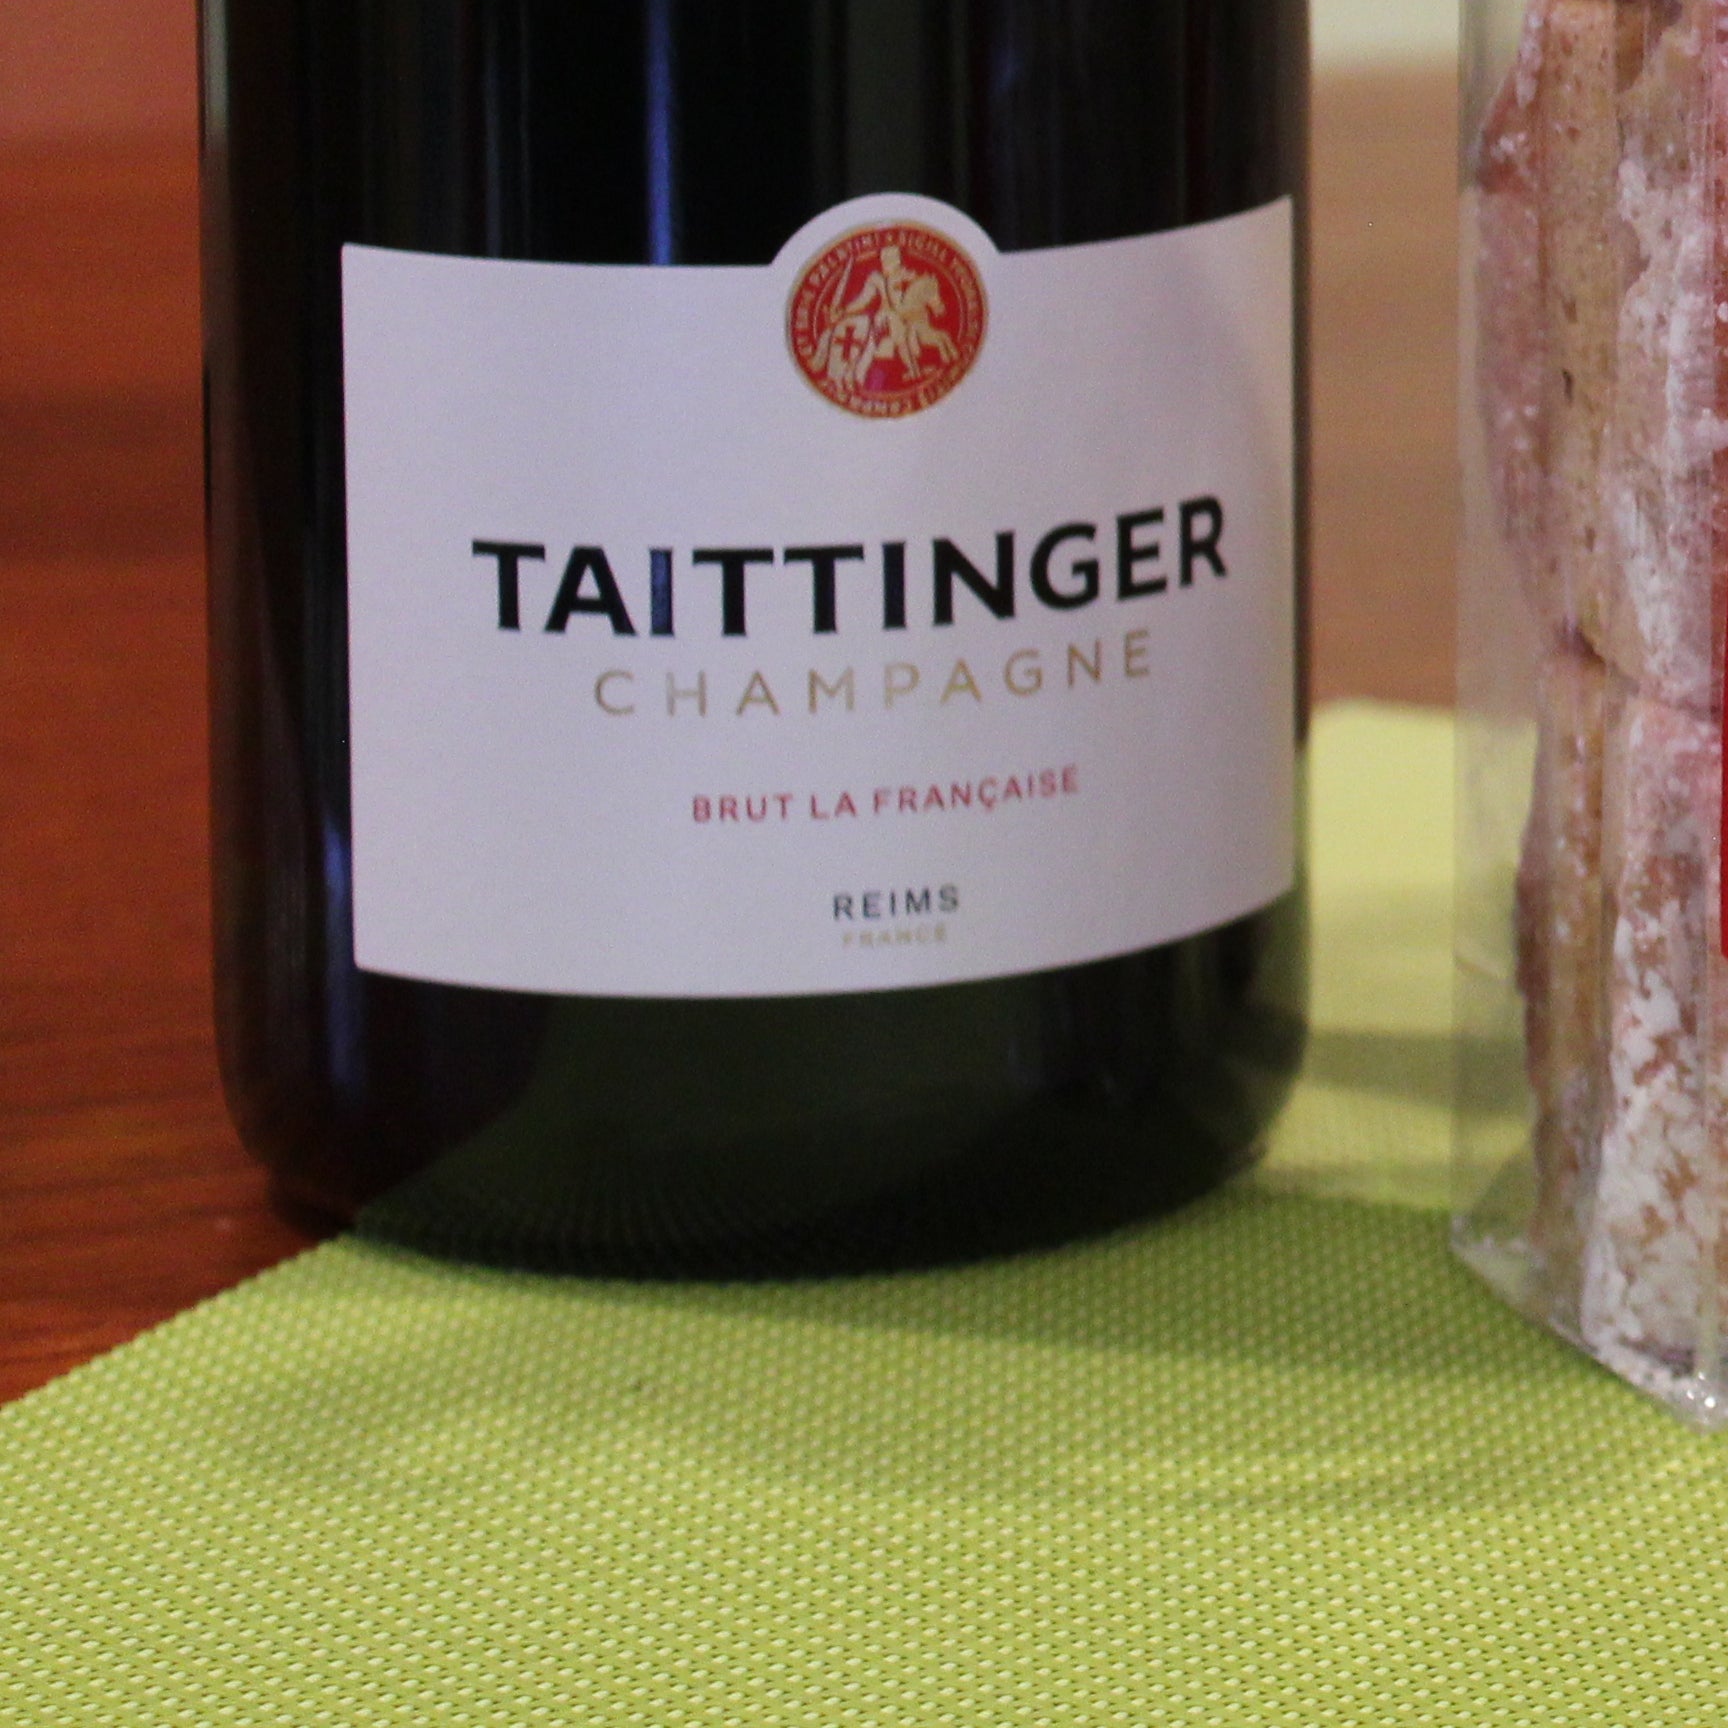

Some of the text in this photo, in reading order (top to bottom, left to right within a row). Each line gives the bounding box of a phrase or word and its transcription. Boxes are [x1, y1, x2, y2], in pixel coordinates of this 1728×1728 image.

[471, 495, 1229, 638] TAITTINGER
[592, 629, 1153, 718] CHAMPAGNE
[692, 765, 1080, 824] BRUT LA FRANÇAISE
[832, 885, 961, 921] REIMS
